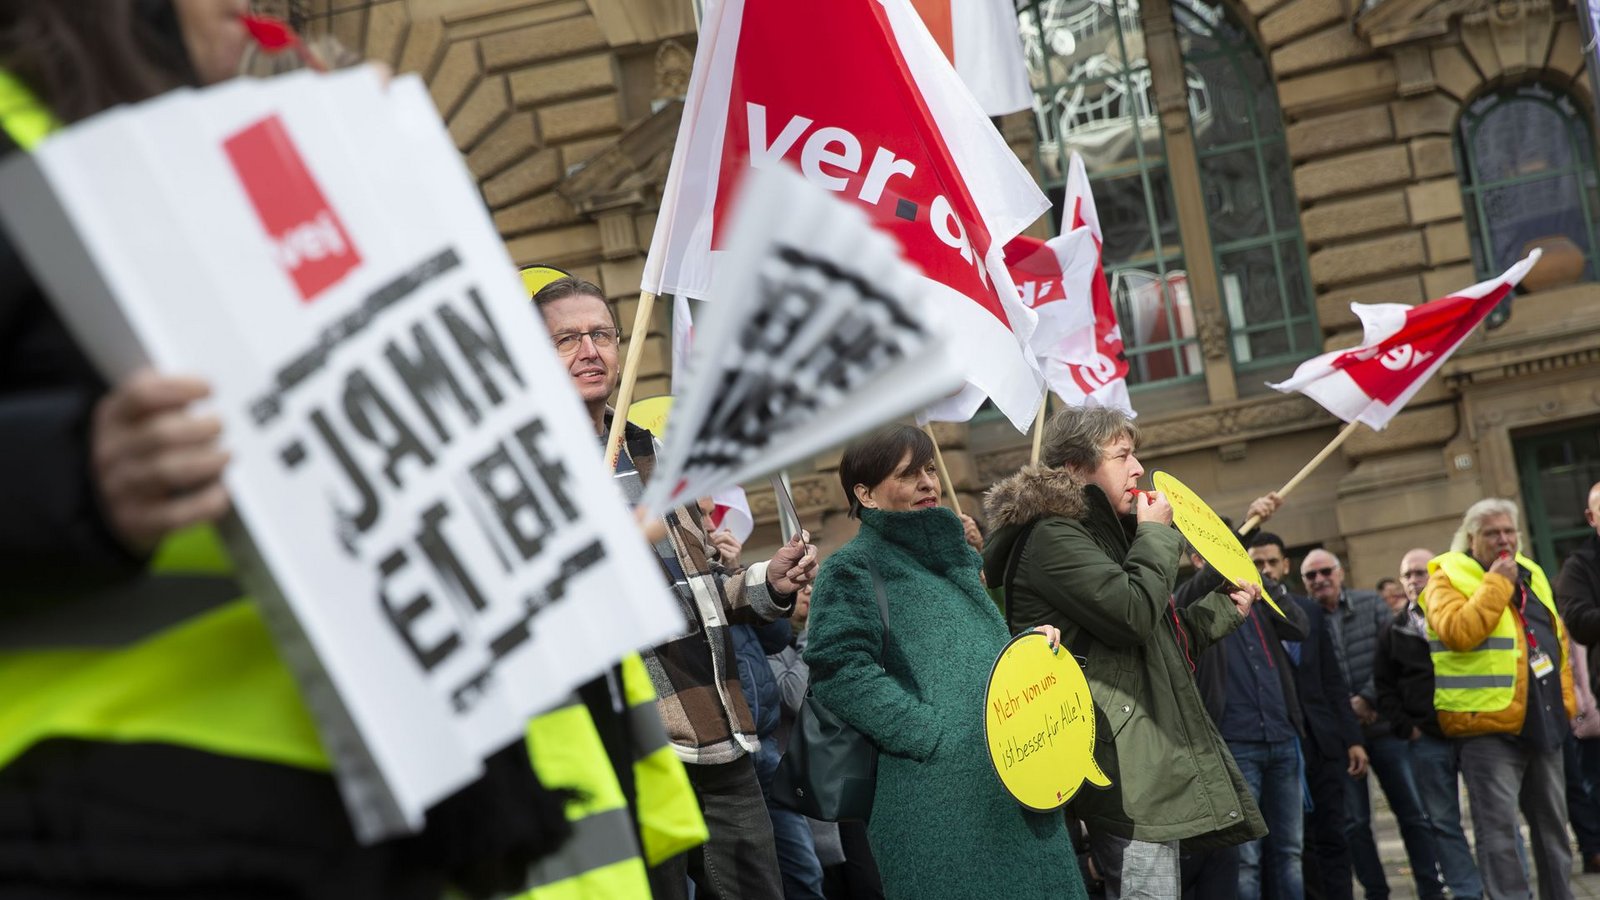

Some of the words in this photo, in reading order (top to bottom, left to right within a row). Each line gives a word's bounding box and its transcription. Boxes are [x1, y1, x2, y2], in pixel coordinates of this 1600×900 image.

[746, 101, 988, 291] ver.d
[993, 689, 1020, 725] Mehr
[1022, 684, 1041, 705] von
[1041, 672, 1057, 691] uns
[999, 739, 1015, 770] ist
[1013, 730, 1045, 763] besser
